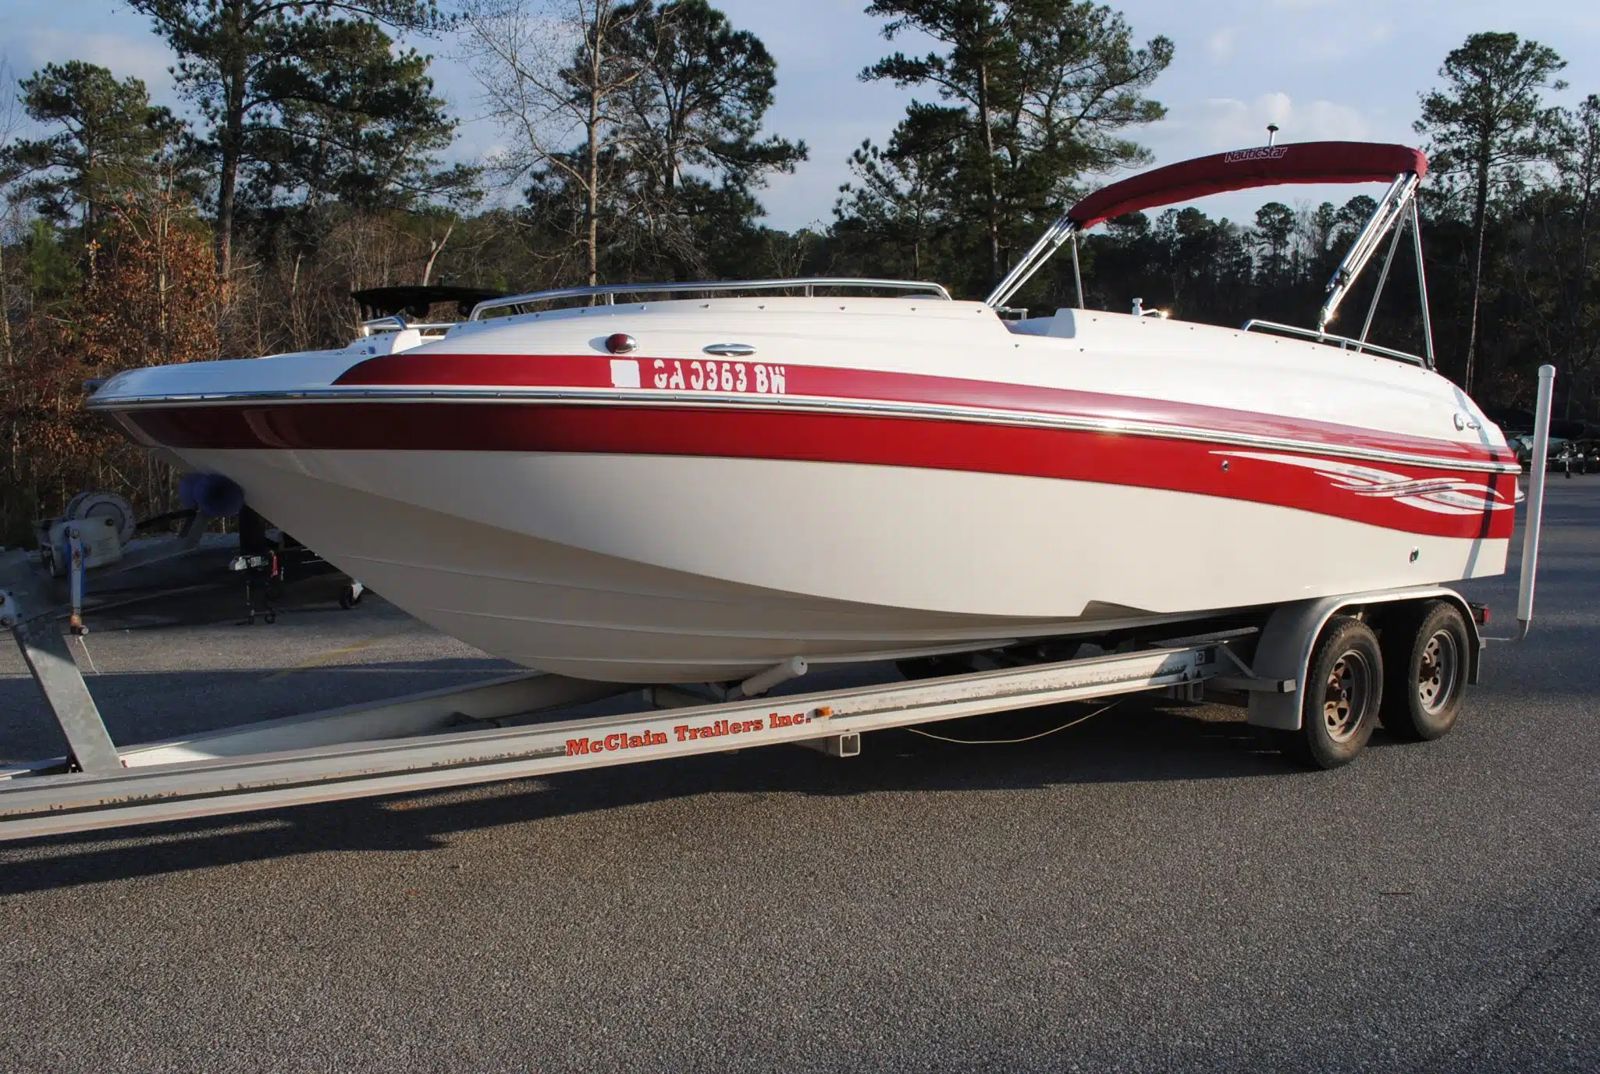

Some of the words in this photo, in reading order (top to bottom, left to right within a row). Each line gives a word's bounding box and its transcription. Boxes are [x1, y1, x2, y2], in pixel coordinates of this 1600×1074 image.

[1224, 147, 1287, 163] NauticStar
[653, 358, 686, 390] GA
[566, 730, 667, 756] McClain
[674, 719, 764, 741] Trailers
[769, 713, 811, 729] Inc.
